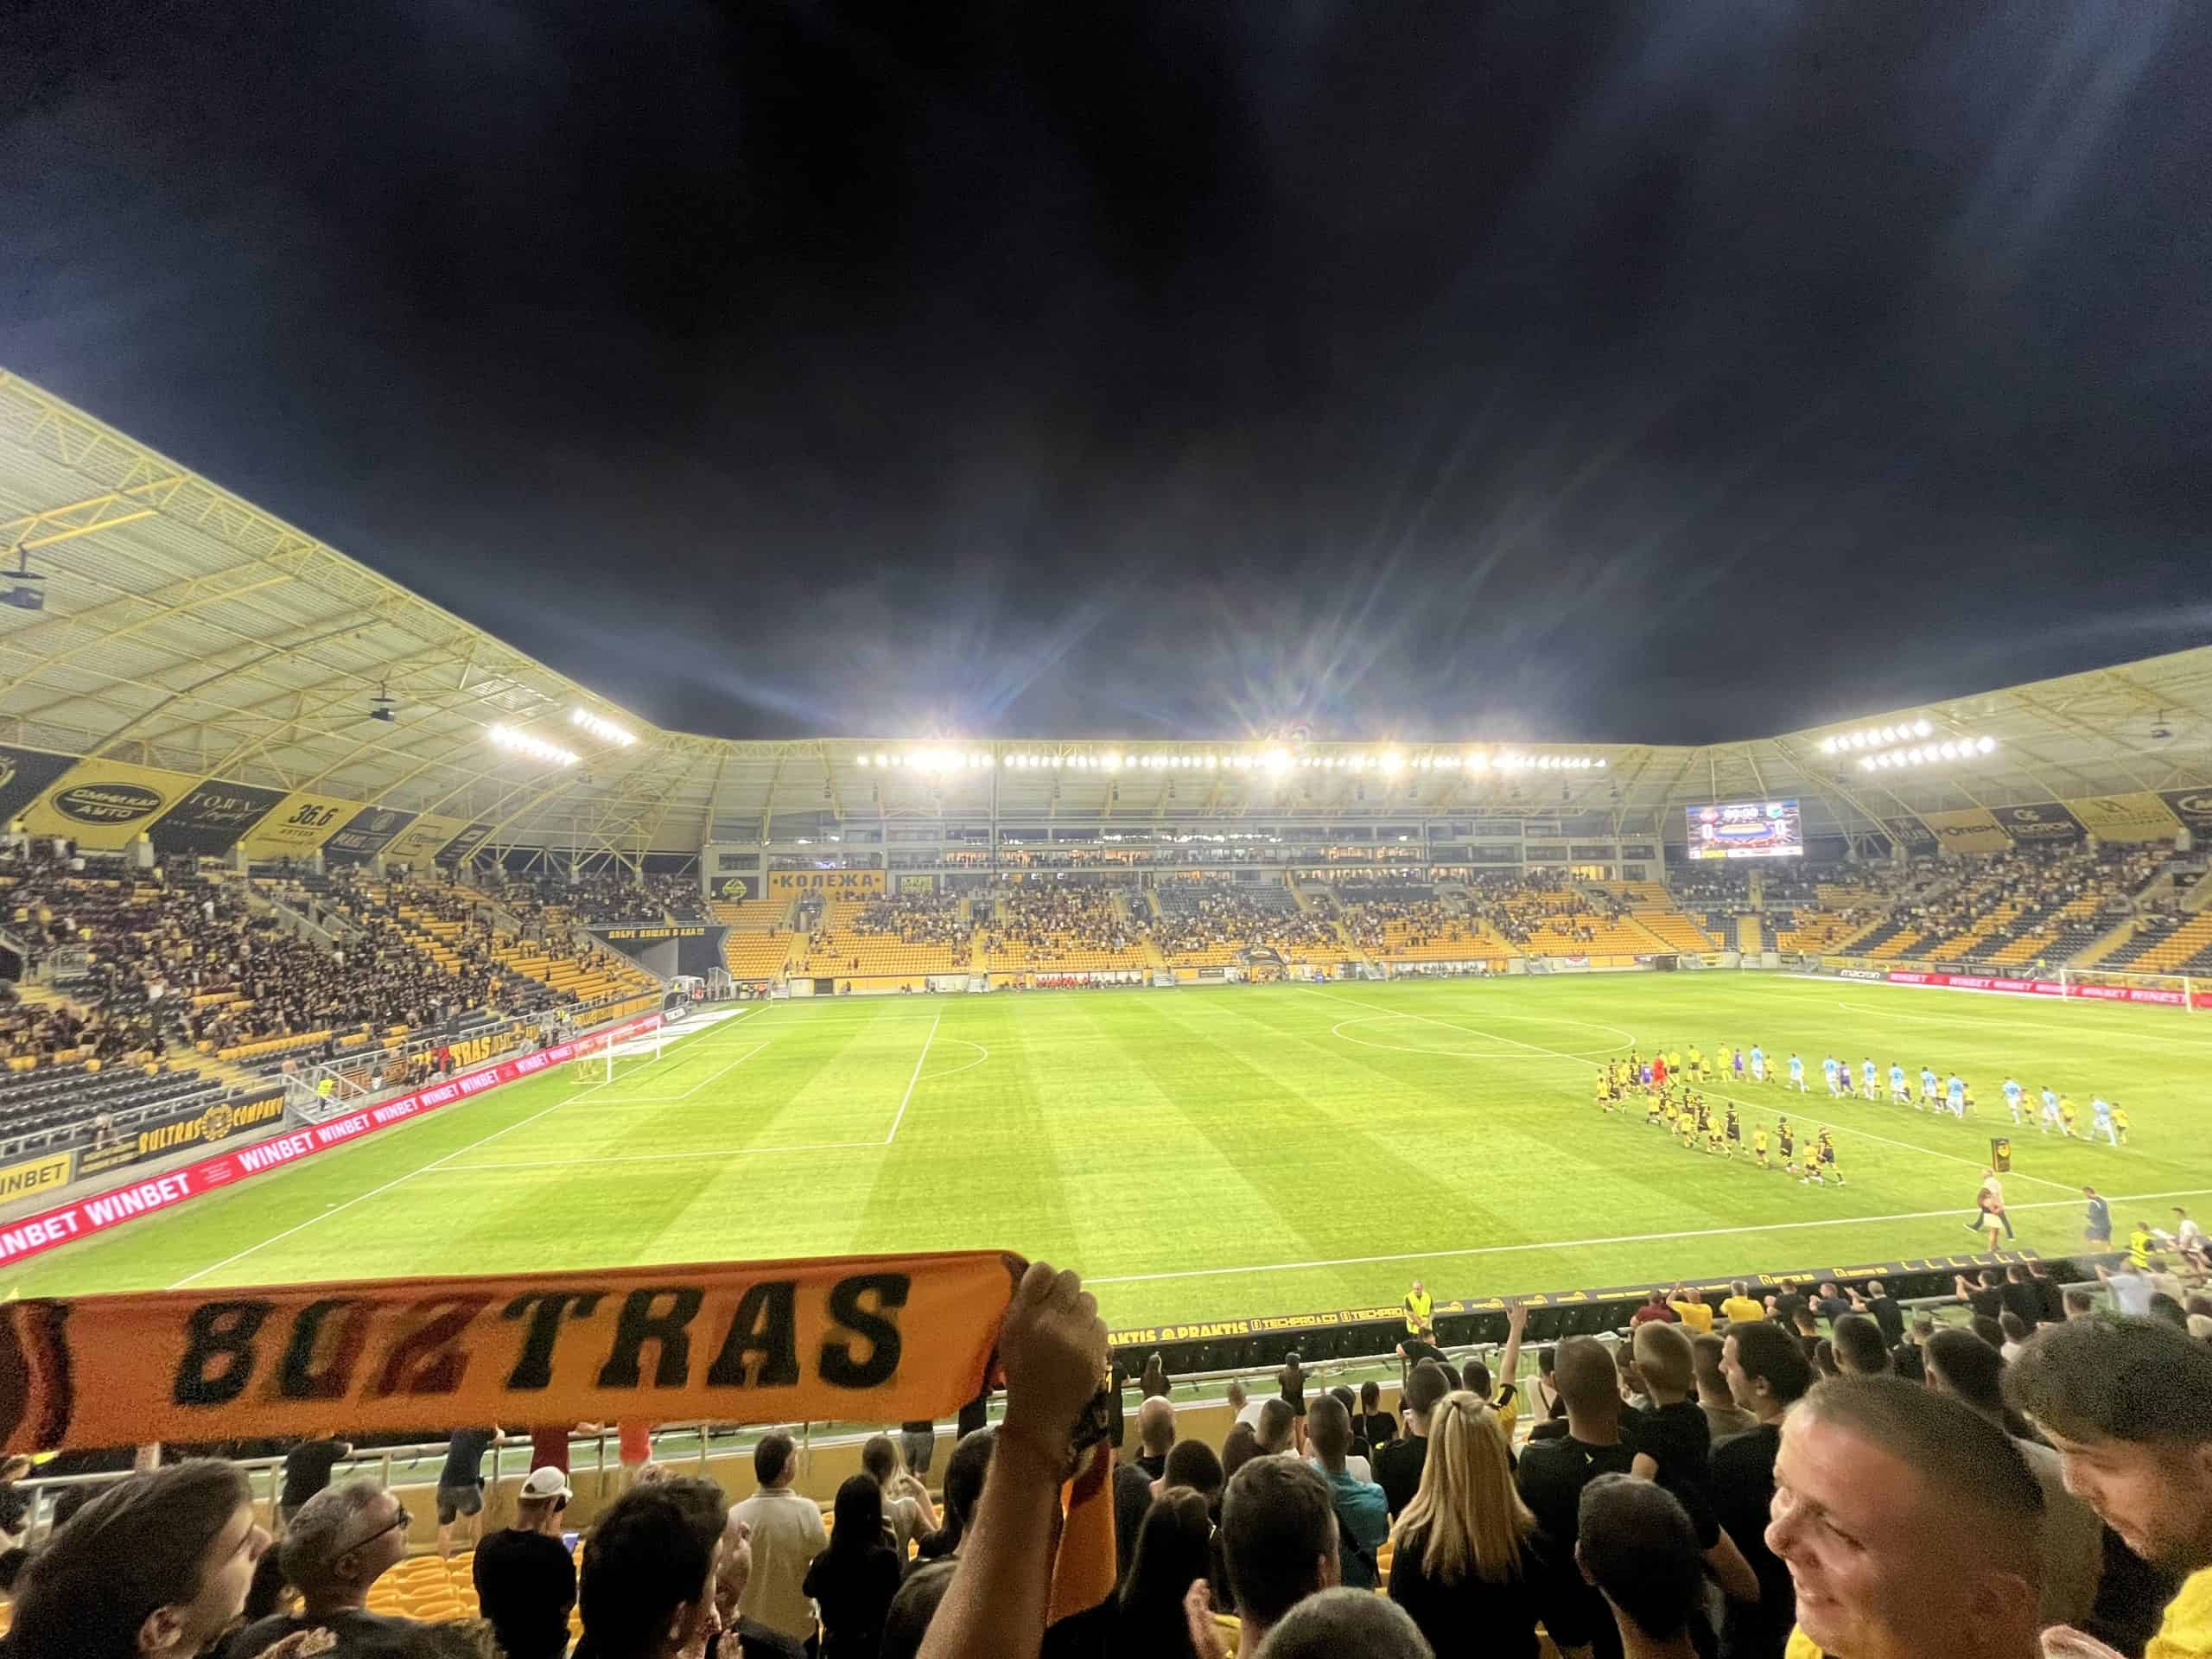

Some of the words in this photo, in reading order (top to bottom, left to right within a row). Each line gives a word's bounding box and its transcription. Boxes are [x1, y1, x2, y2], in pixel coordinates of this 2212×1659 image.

[288, 803, 339, 827] 36.6
[780, 874, 873, 888] КОЛЕЖА
[232, 1095, 285, 1128] COMPANY
[0, 1211, 79, 1258] NBET
[84, 1173, 191, 1227] WINBET
[238, 1132, 315, 1173] WINBET
[316, 1115, 371, 1144] WINBET
[372, 1097, 419, 1124] WINBET
[420, 1083, 460, 1107] WINBET
[459, 1069, 499, 1095] WINBET
[0, 1163, 65, 1195] INBET
[1108, 1330, 1156, 1345] AKTIS
[1178, 1322, 1249, 1339] PRAKTIS
